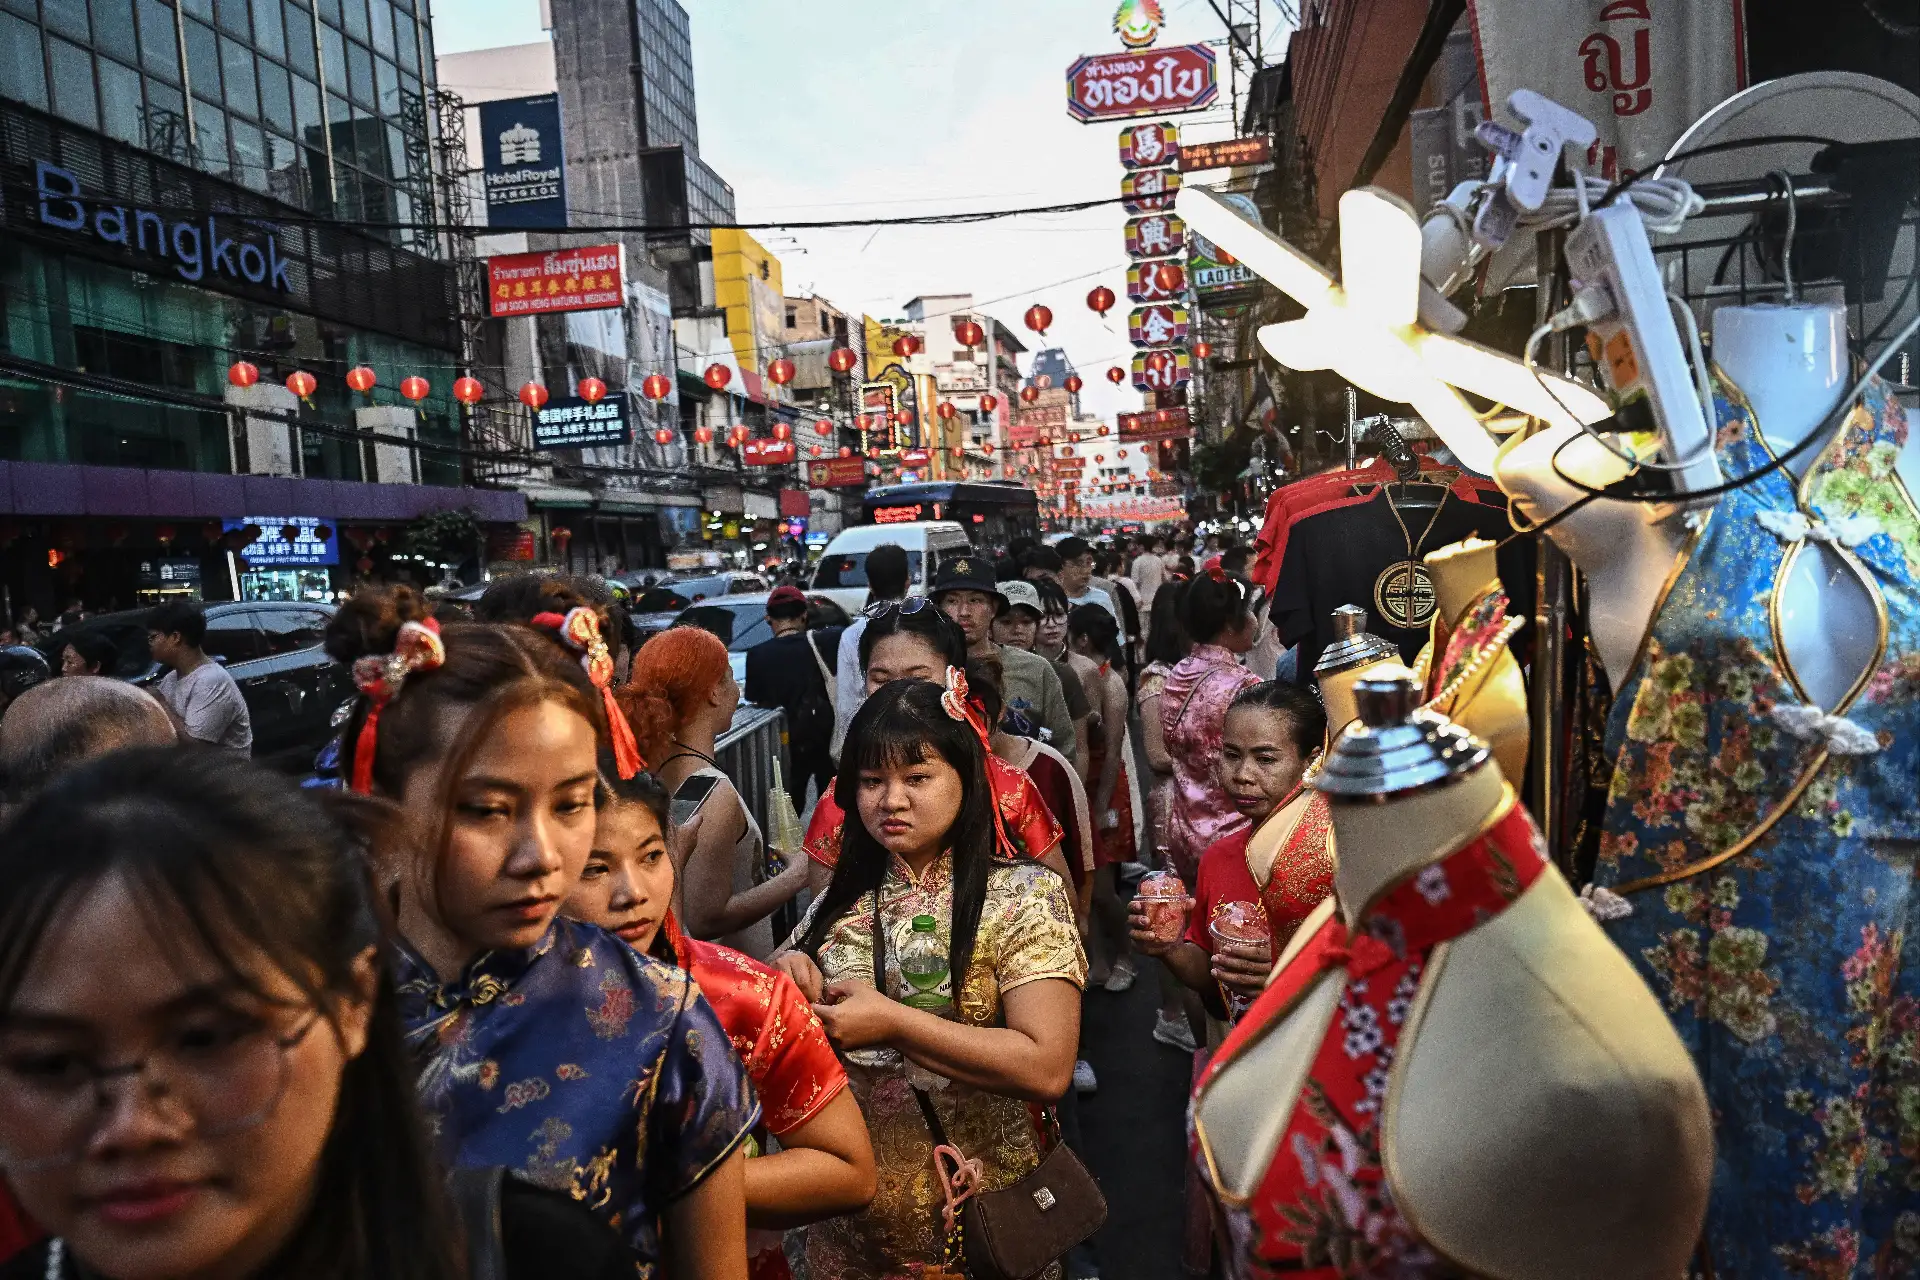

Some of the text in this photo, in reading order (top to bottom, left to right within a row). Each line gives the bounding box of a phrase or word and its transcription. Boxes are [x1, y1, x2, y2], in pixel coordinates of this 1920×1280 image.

[486, 167, 560, 186] Hotel Royal
[489, 186, 558, 200] BANGKOK
[34, 158, 296, 293] Bangkok
[1198, 266, 1257, 285] LAOTEN
